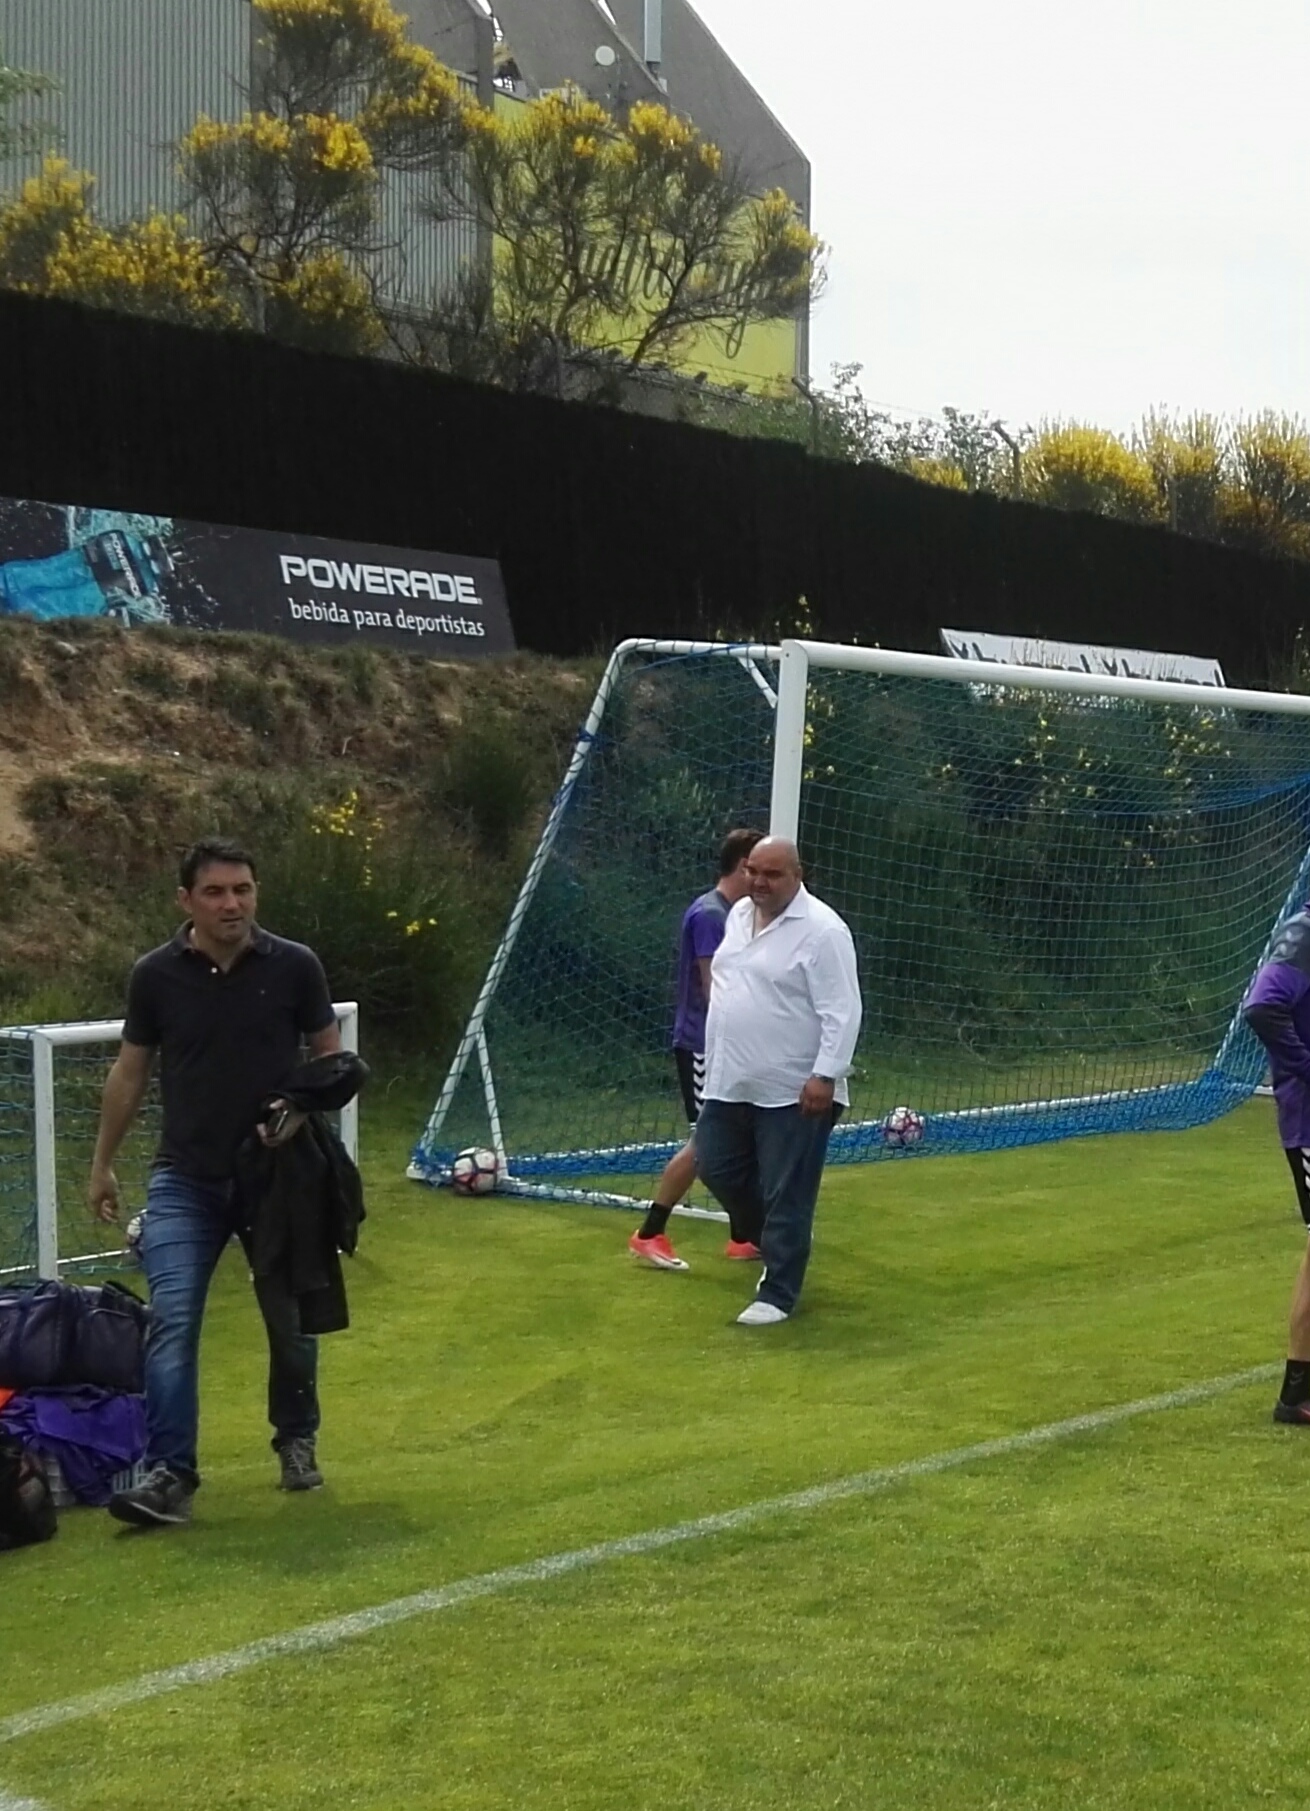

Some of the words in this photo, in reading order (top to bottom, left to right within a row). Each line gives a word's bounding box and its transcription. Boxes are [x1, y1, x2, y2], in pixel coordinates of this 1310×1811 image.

[279, 555, 481, 605] POWERADE
[288, 597, 350, 624] bebida
[352, 609, 394, 630] para
[396, 608, 486, 637] deportistas
